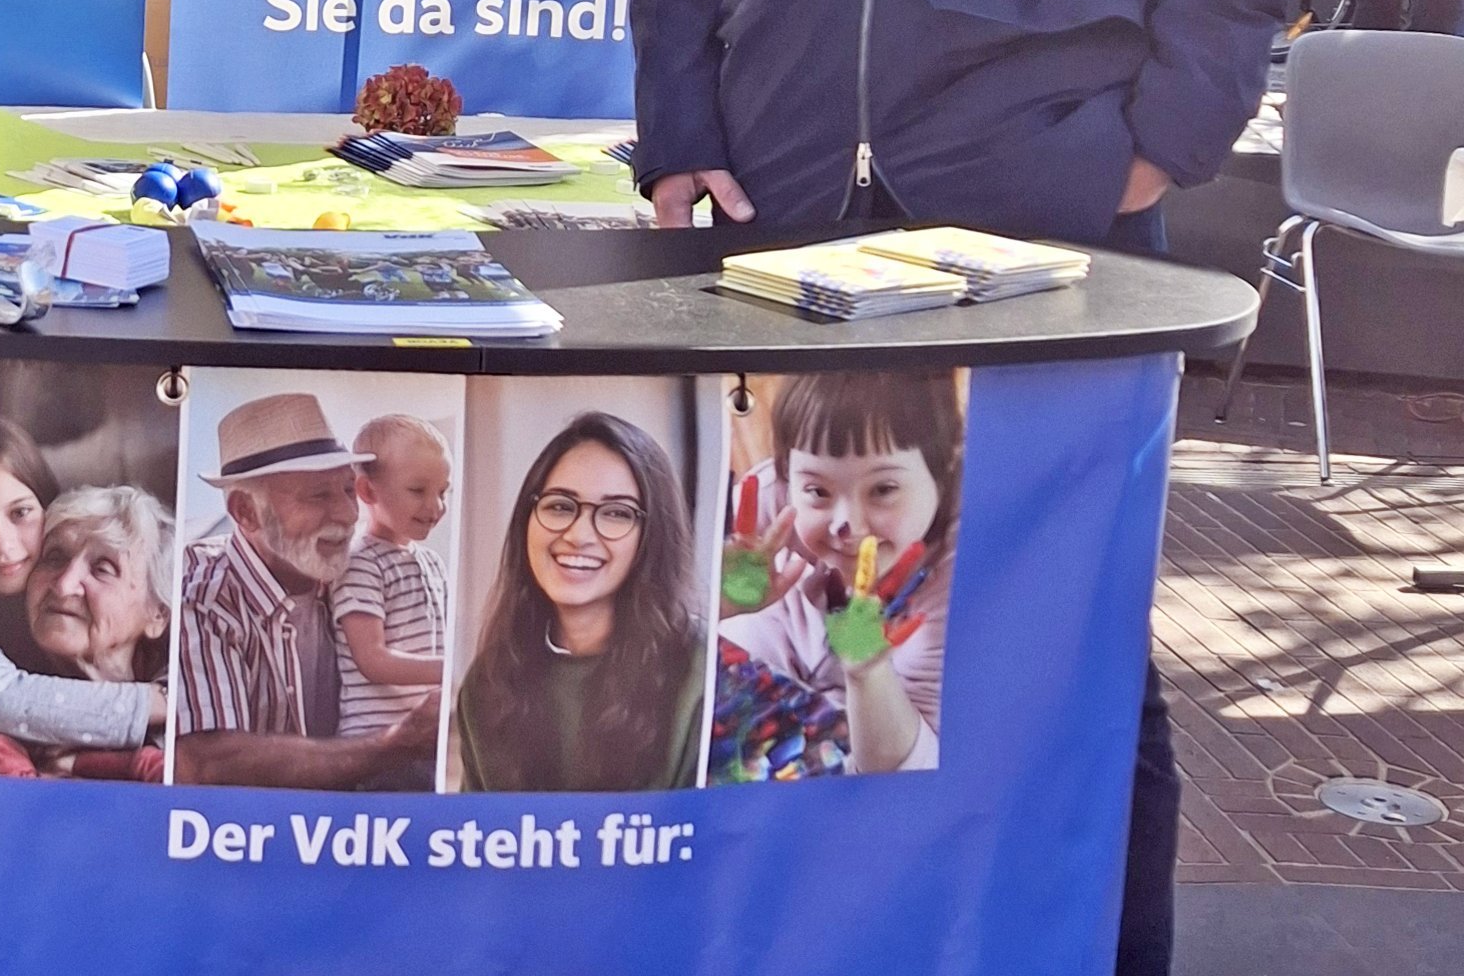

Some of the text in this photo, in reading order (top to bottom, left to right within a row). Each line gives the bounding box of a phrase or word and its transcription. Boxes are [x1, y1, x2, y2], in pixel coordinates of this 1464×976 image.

[167, 809, 694, 868] Der VdK steht für:
